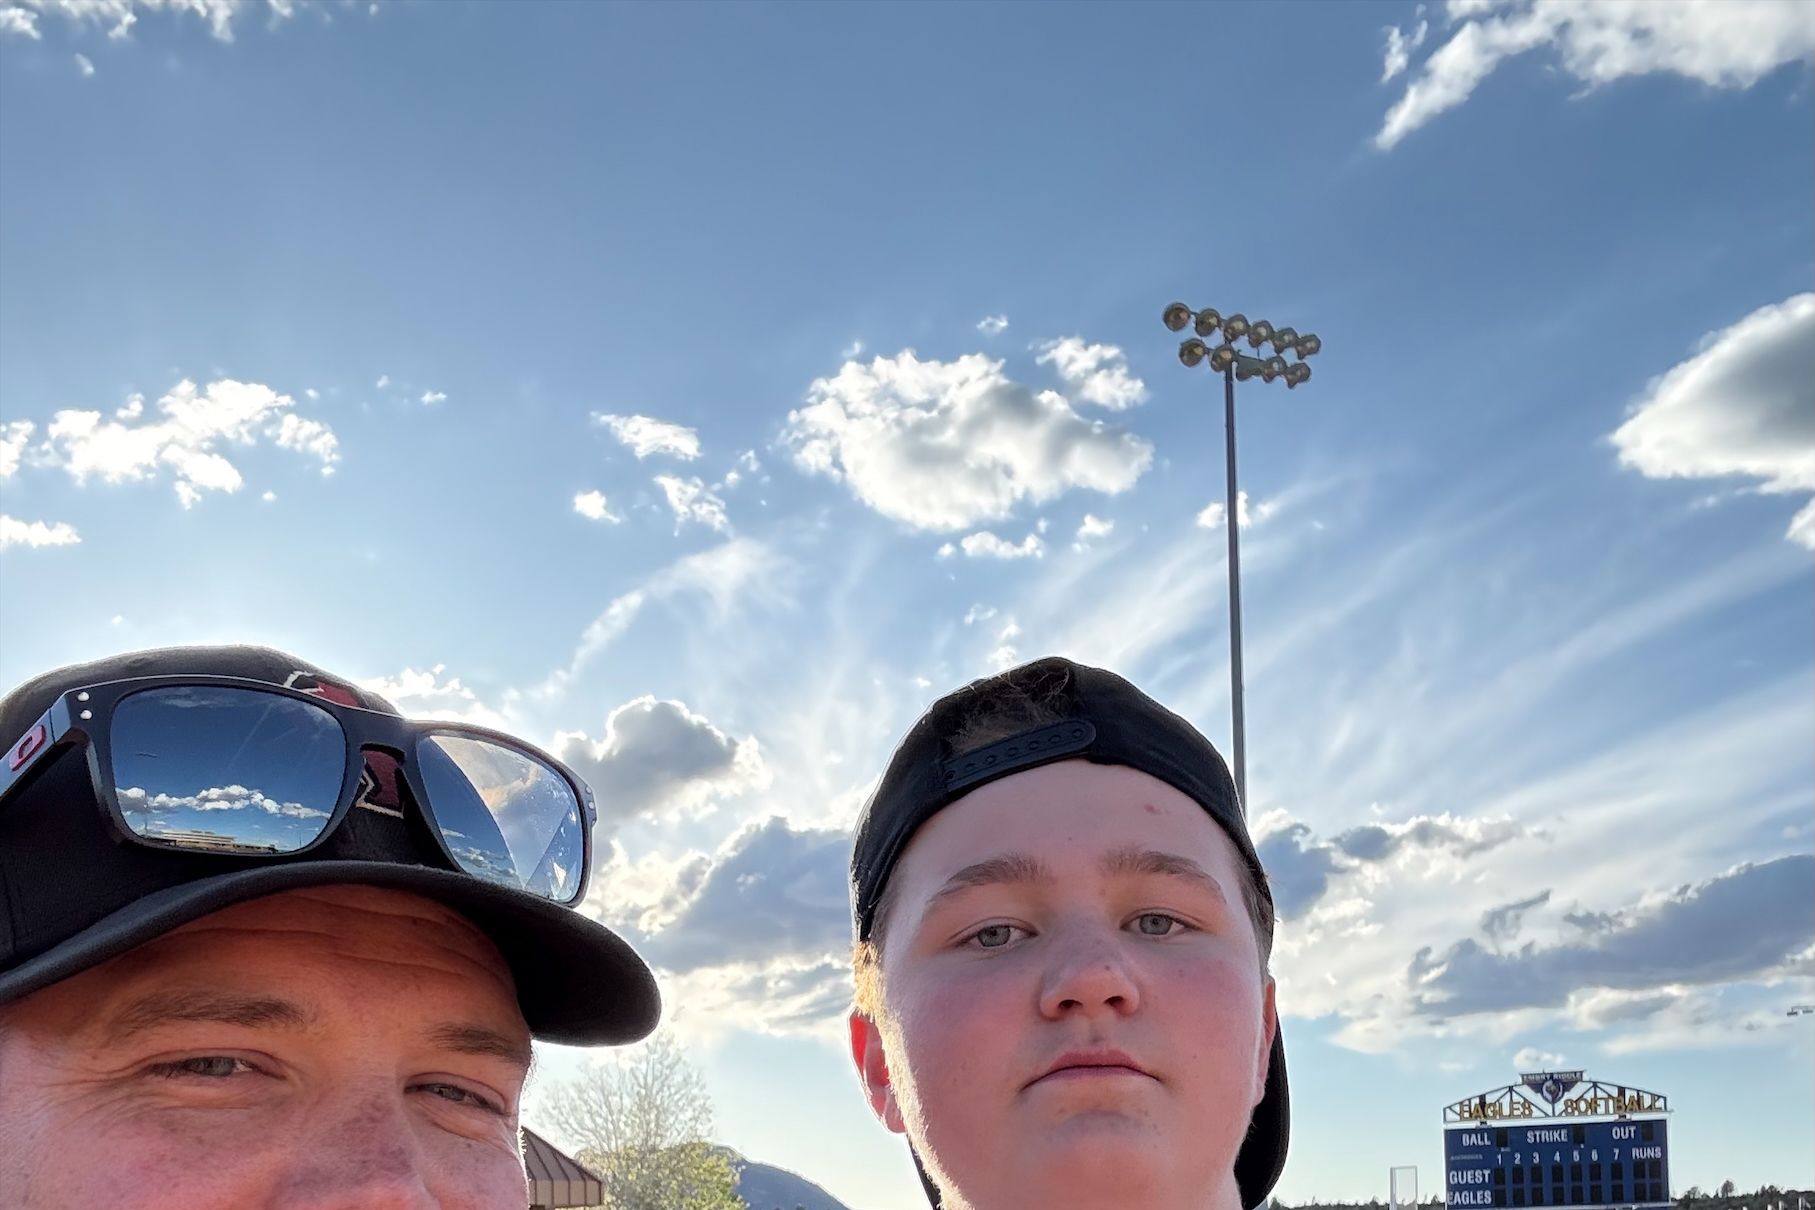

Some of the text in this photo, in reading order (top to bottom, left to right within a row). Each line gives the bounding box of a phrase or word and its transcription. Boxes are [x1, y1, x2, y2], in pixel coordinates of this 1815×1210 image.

[1459, 1094, 1663, 1120] EAGLES SOFTBALL
[1462, 1126, 1637, 1146] BALL STRIKE OUT
[1497, 1153, 1502, 1165] 1
[1514, 1152, 1521, 1164] 2
[1532, 1151, 1540, 1164] 3
[1553, 1151, 1561, 1163] 4
[1573, 1150, 1580, 1162] 5
[1591, 1149, 1598, 1161] 6
[1613, 1148, 1620, 1160] 7
[1631, 1146, 1662, 1160] RUNS
[1449, 1168, 1491, 1185] GUEST
[1446, 1190, 1492, 1206] EAGLES
